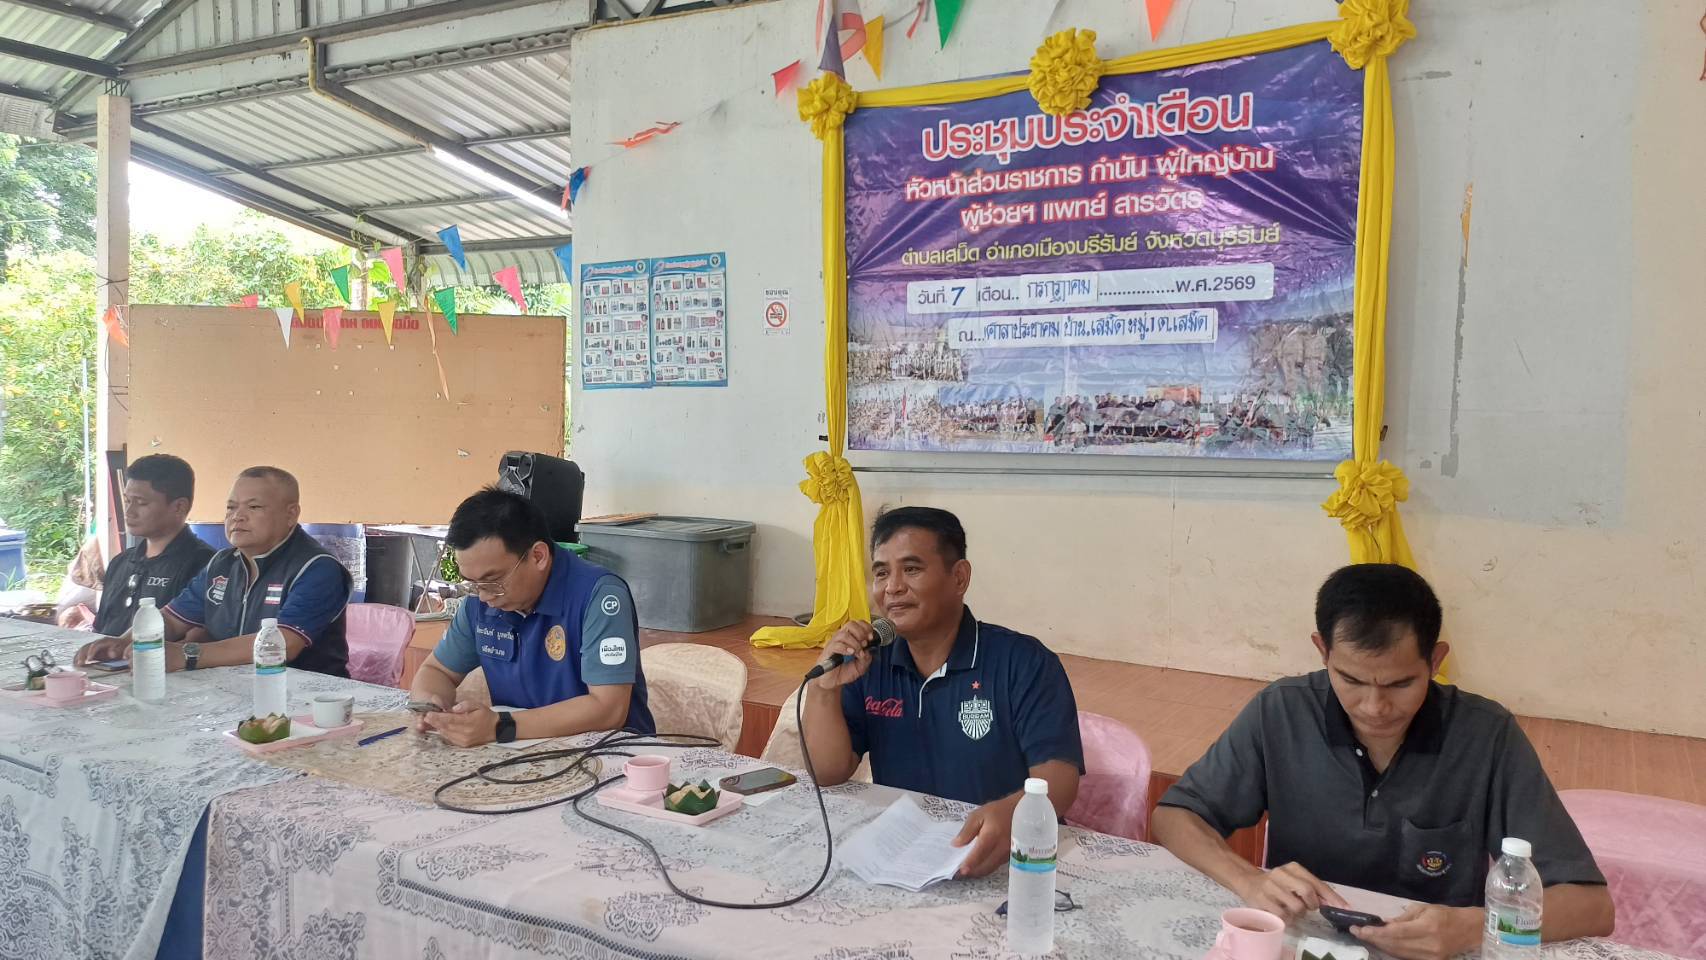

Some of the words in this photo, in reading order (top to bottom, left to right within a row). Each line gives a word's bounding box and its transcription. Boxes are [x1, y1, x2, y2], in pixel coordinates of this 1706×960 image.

[922, 88, 1254, 165] ประชุมประจำเดือน
[906, 165, 1083, 200] หัวหน้าส่วนราชการ
[1090, 155, 1147, 182] กำนัน
[1156, 146, 1275, 181] ผู้ใหญ่บ้าน
[961, 202, 1035, 233] ผู้ช่วยฯ
[1043, 192, 1107, 221] แพทย์
[1114, 188, 1204, 215] สารวัตร
[901, 242, 980, 266] ตำบลเสม็ด
[1145, 222, 1280, 251] จังหวัดบุรีรัมย์
[950, 286, 967, 306] 7
[604, 600, 618, 610] CP
